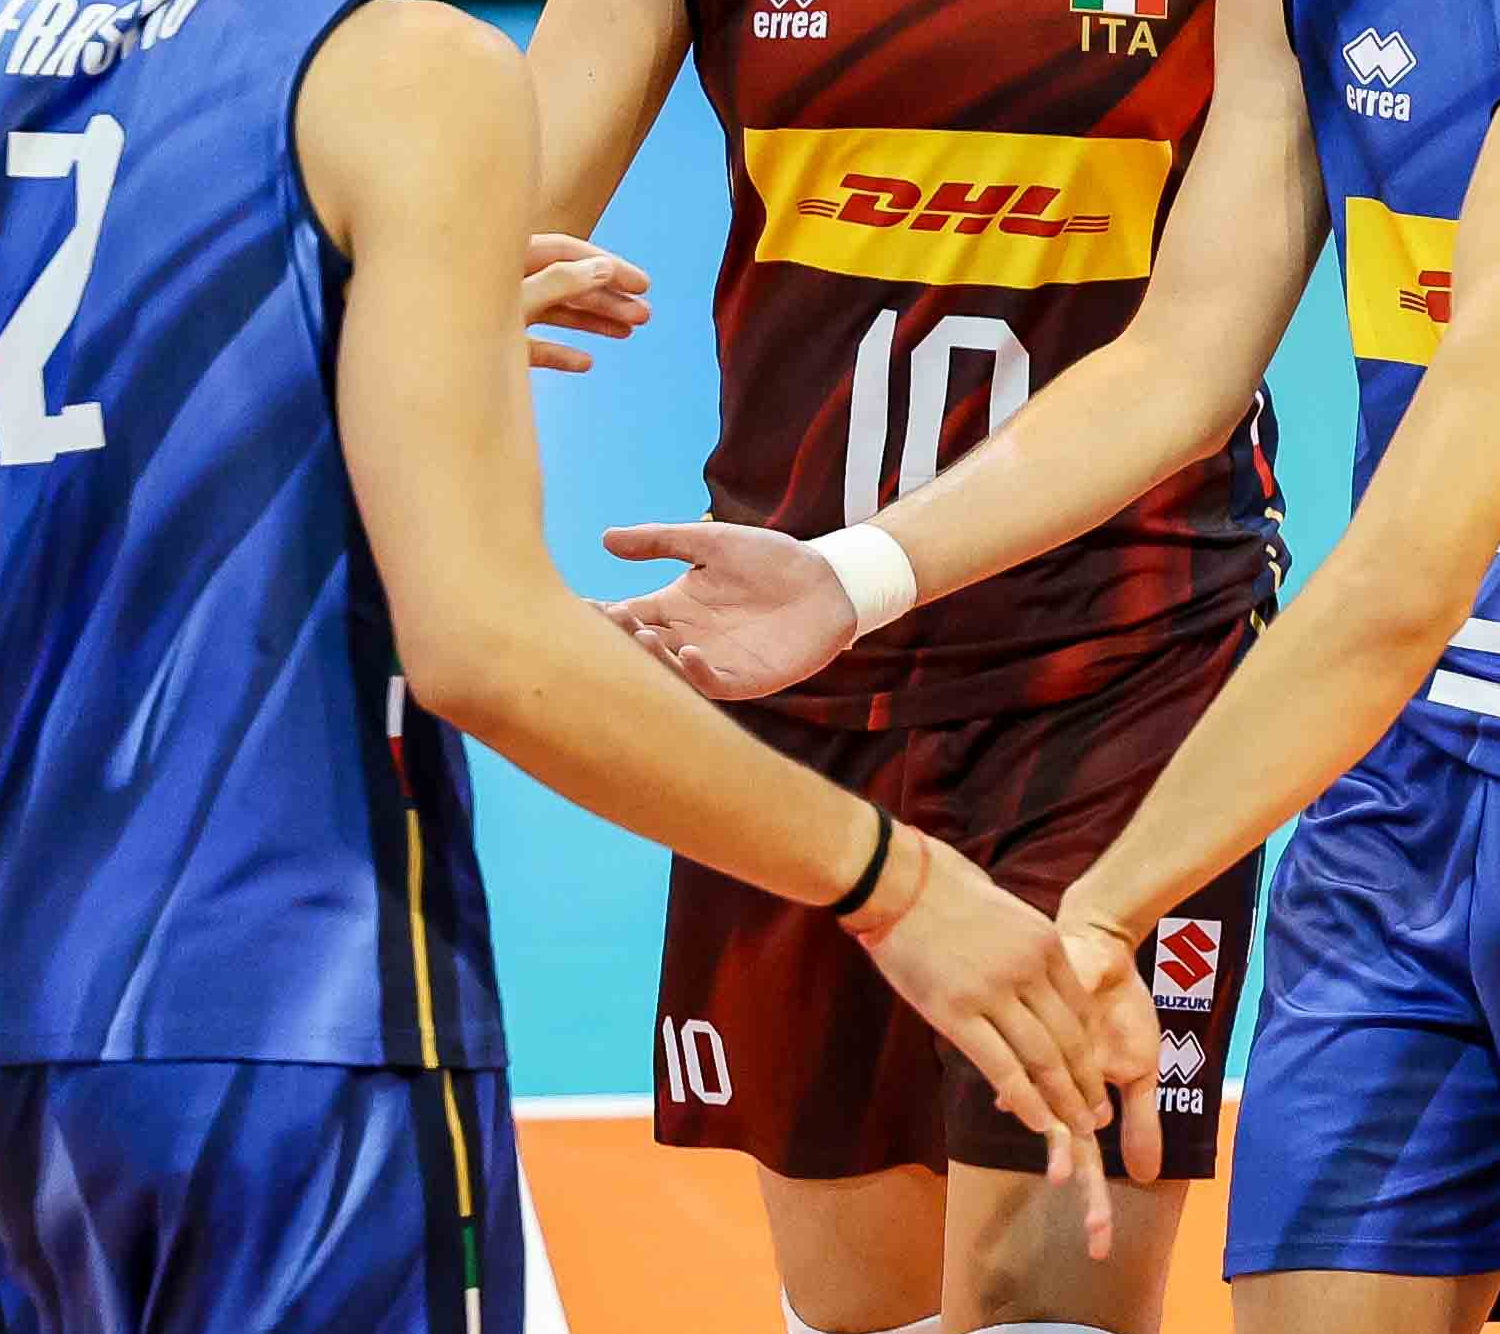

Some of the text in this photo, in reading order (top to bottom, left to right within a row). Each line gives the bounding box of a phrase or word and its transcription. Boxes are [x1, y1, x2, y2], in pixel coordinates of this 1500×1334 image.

[1081, 15, 1158, 58] ITA
[836, 173, 1062, 239] DHL
[844, 308, 1030, 528] 10
[662, 1015, 732, 1105] 10
